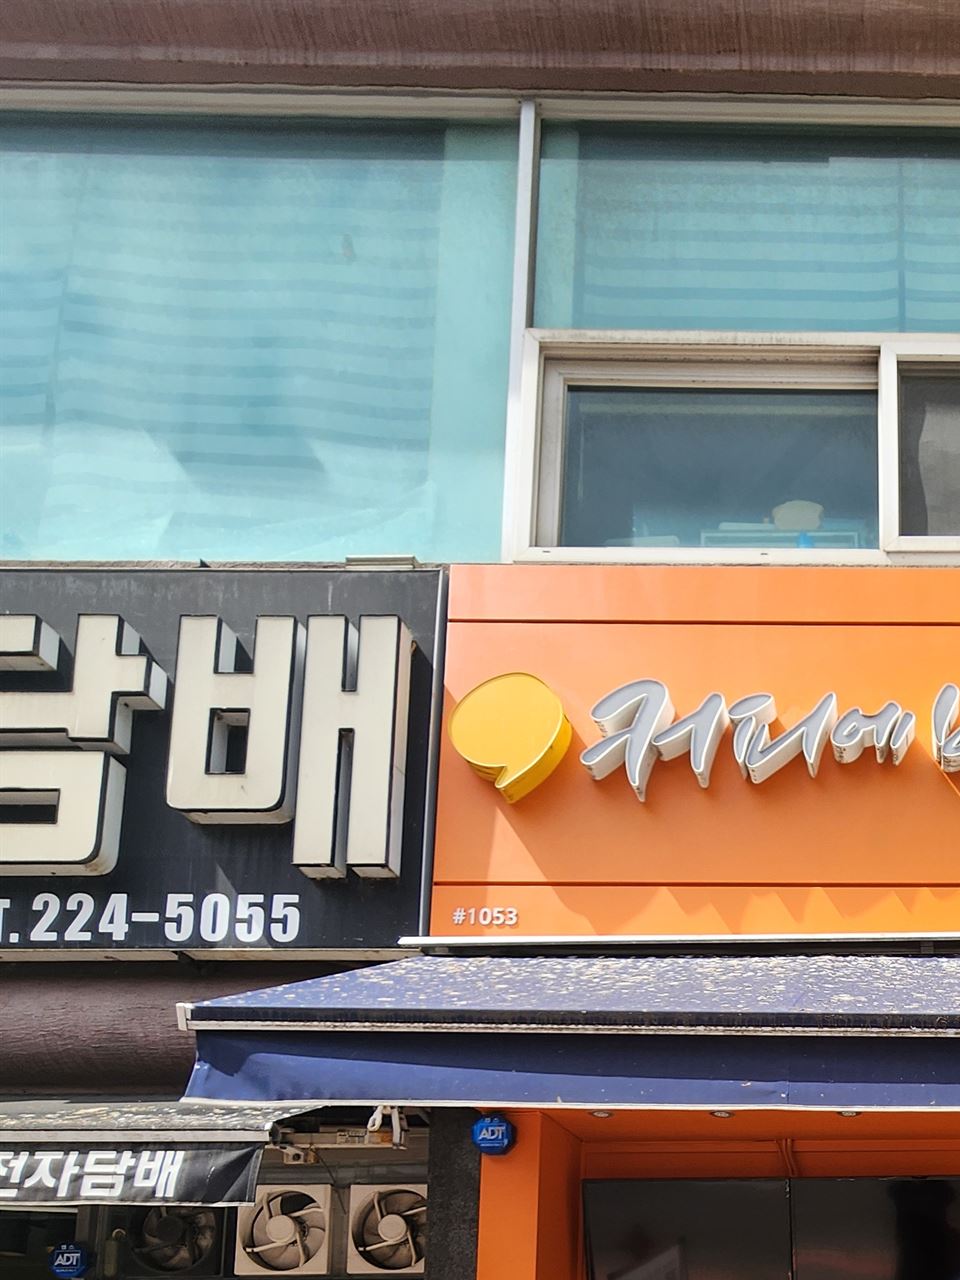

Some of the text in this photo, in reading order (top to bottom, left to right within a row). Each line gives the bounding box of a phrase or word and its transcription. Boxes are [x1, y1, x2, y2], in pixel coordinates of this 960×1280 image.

[452, 906, 518, 926] #1053
[478, 1126, 506, 1140] ADT
[54, 1253, 81, 1266] ADT
